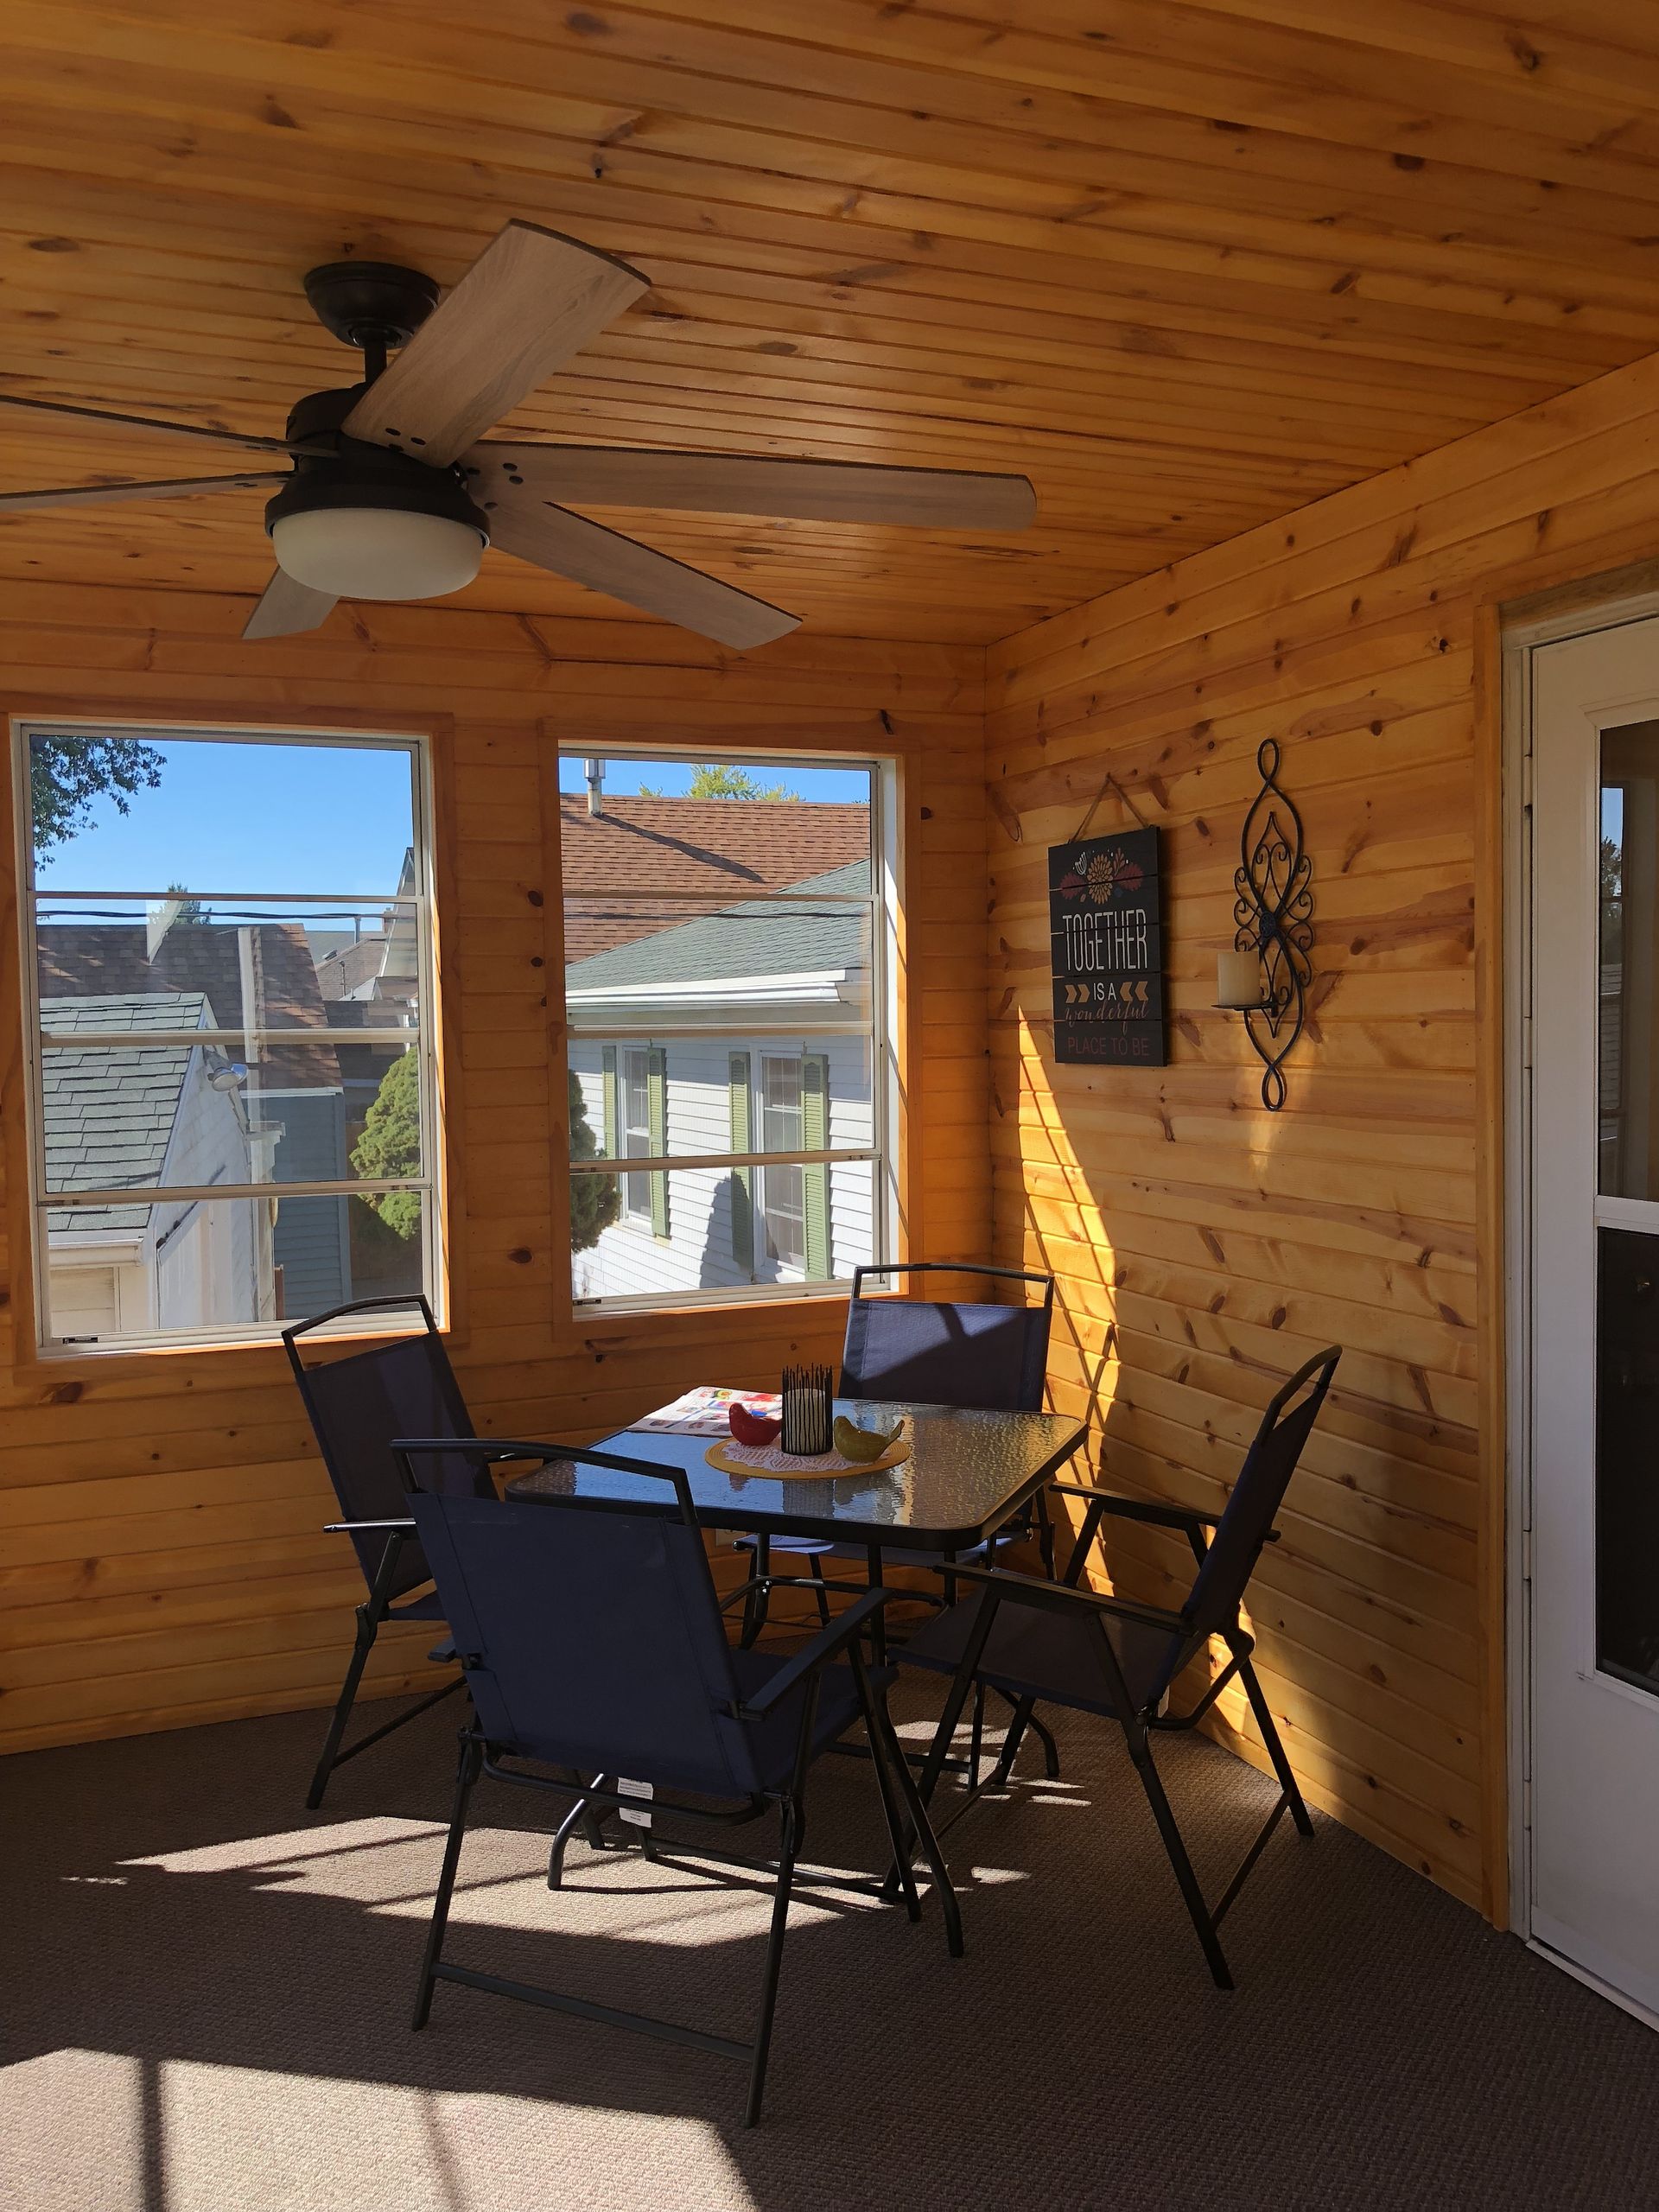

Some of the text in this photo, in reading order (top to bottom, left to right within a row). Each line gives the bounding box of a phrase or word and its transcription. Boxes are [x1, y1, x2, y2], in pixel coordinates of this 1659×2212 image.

[1062, 909, 1147, 971] TOGETHER
[1093, 982, 1116, 1001] IS A
[1065, 1000, 1148, 1035] wonderful
[1067, 1037, 1150, 1056] PLACE TO BE
